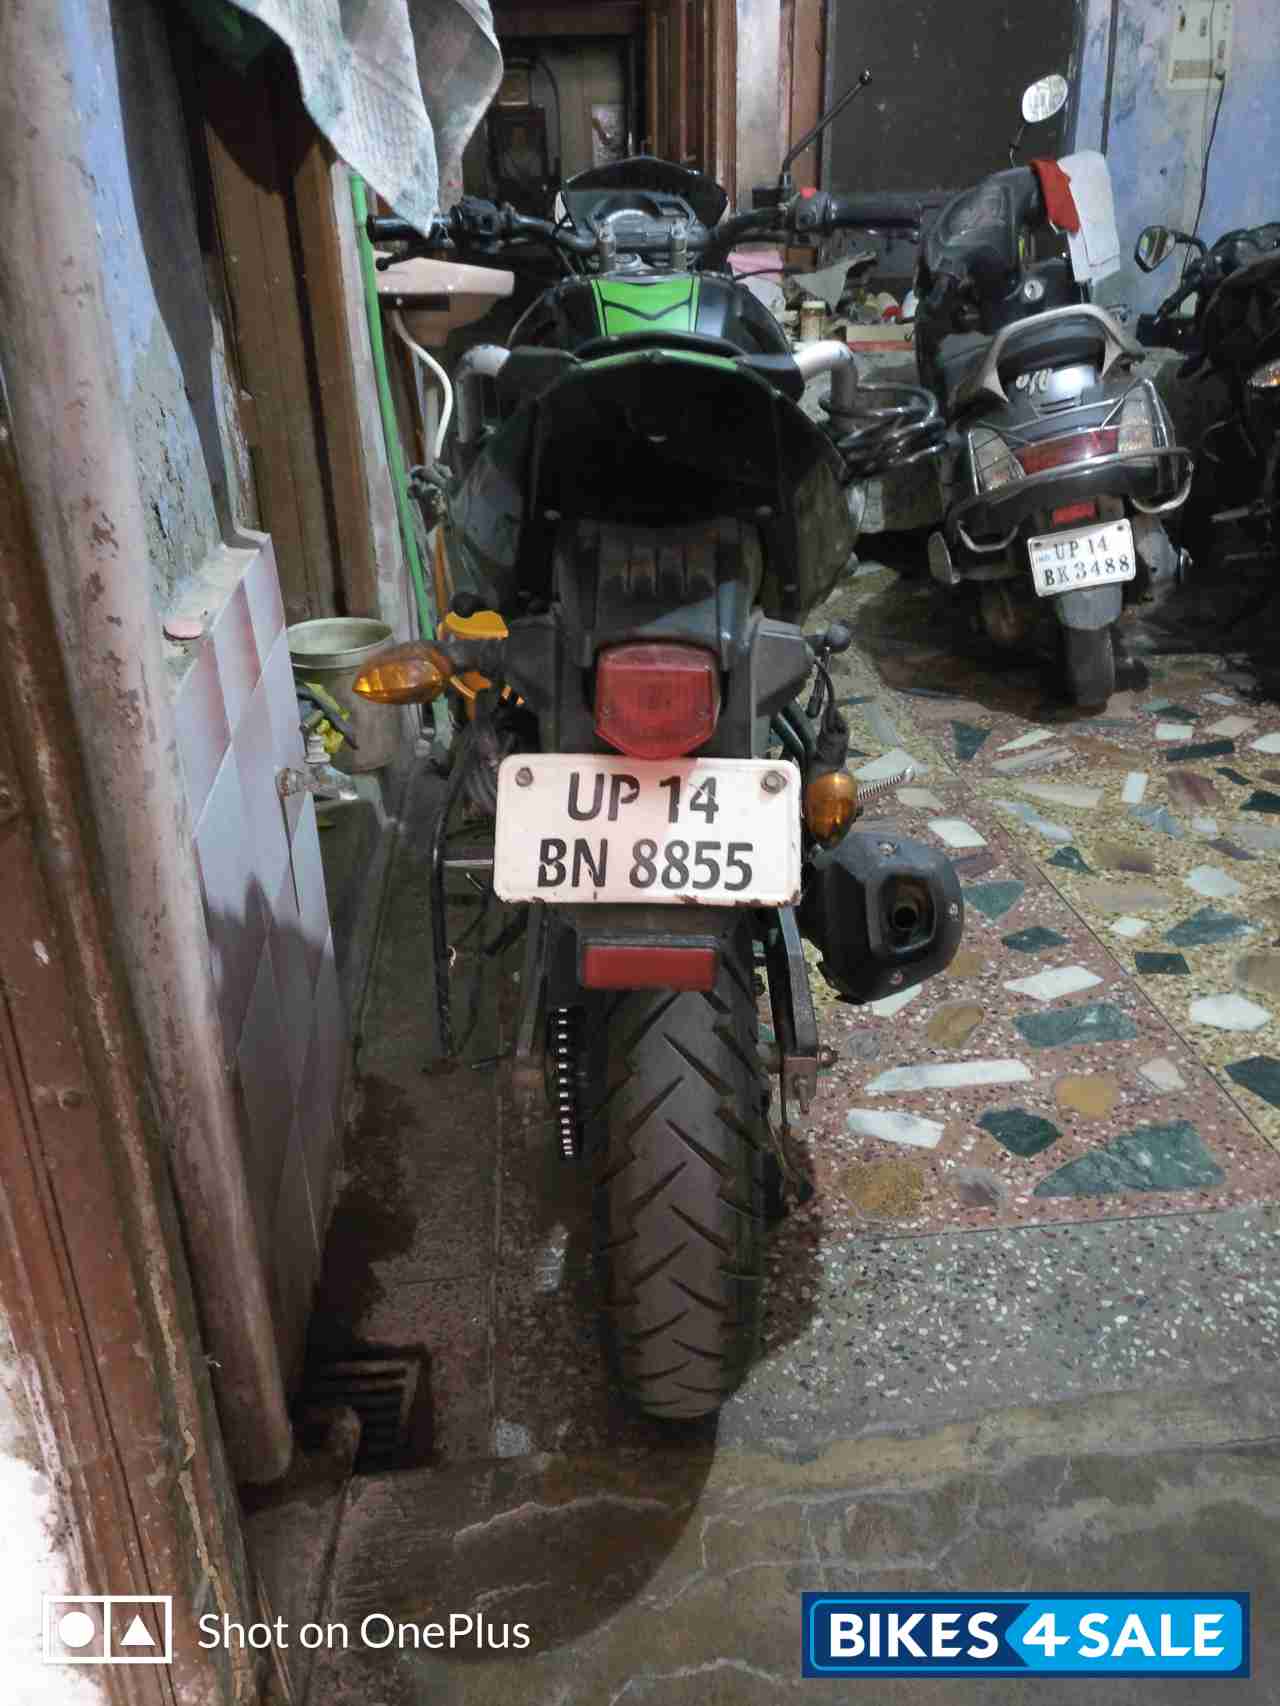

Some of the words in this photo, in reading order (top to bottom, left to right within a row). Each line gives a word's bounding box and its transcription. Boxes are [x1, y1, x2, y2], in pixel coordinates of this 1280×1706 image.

[1055, 541, 1079, 561] UP
[1088, 535, 1108, 555] 14
[567, 772, 640, 821] UP
[659, 775, 719, 824] 14
[537, 838, 608, 888] BN
[629, 838, 754, 891] 8855
